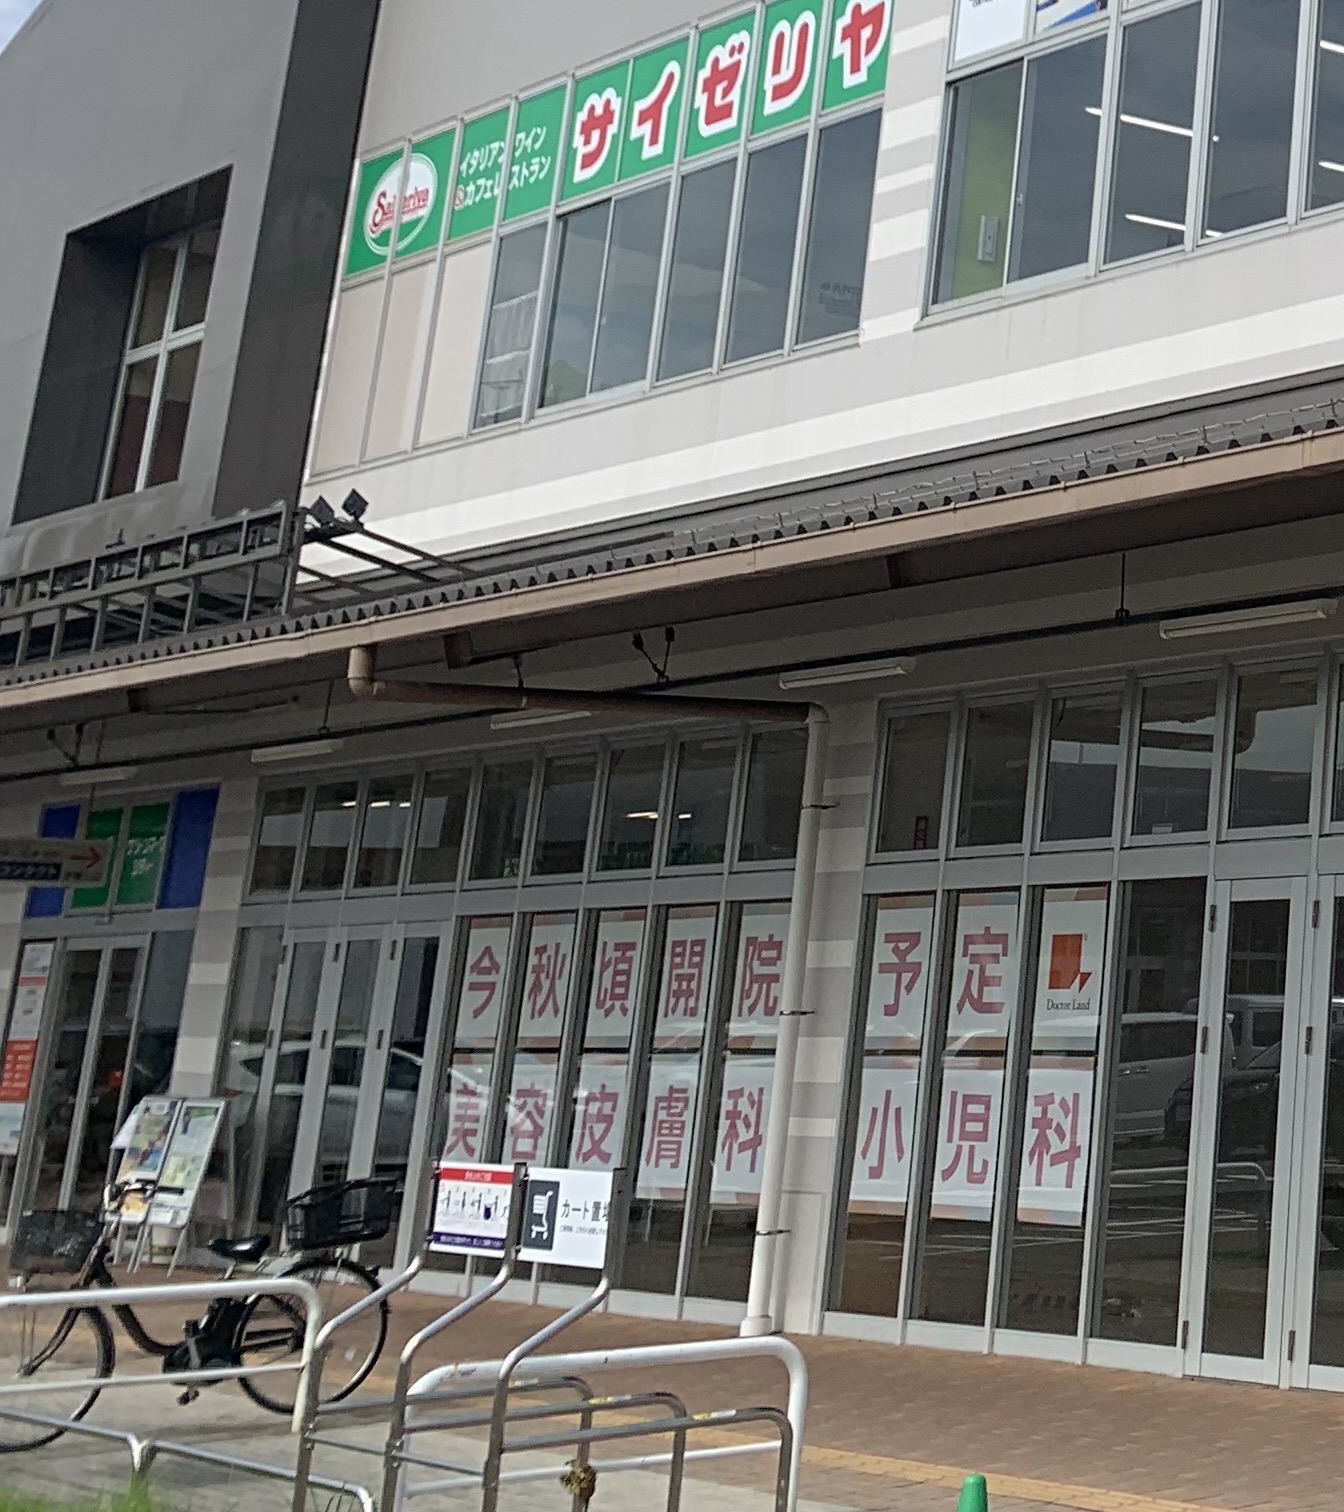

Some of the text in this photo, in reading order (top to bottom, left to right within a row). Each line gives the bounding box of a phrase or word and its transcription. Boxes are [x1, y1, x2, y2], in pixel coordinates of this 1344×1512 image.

[466, 925, 1009, 1020] 今秋頃開院 予定
[1072, 997, 1091, 1011] Land
[444, 1082, 1083, 1189] 美容皮膚科 小児科
